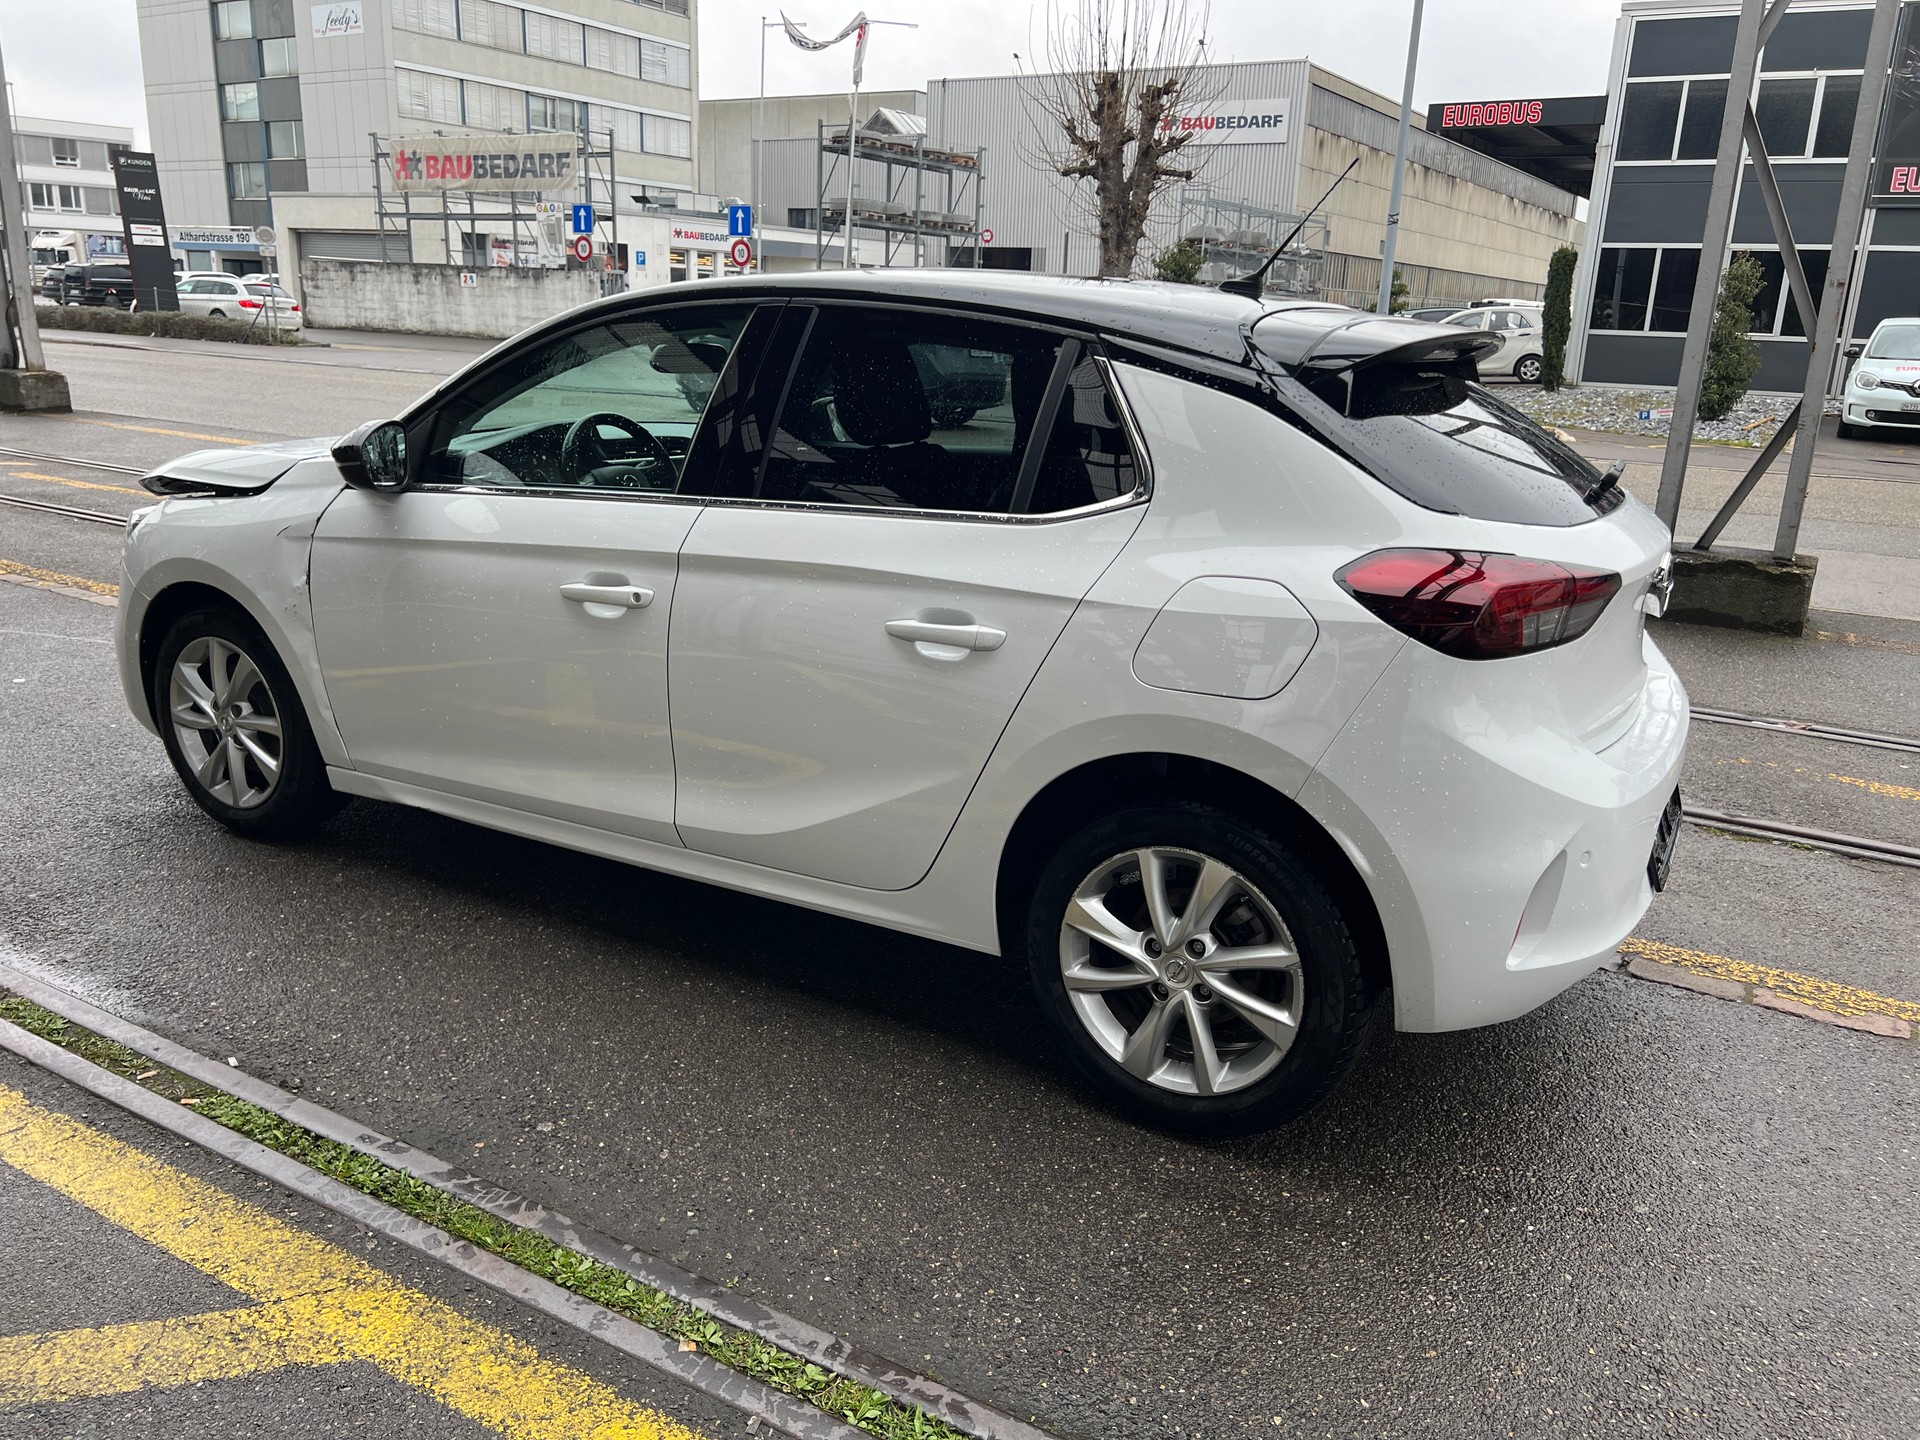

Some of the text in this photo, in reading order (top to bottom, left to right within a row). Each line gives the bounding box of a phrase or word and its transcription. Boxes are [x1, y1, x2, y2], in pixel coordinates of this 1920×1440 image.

[1442, 101, 1543, 128] EUROBUS
[1181, 114, 1284, 131] BAUBEDARF
[425, 152, 571, 180] BAUBEDARF
[180, 232, 250, 243] Althardstrasse 190
[684, 231, 730, 242] BAUBEDARF
[580, 243, 588, 254] 10
[737, 248, 745, 259] 10
[638, 252, 644, 264] P
